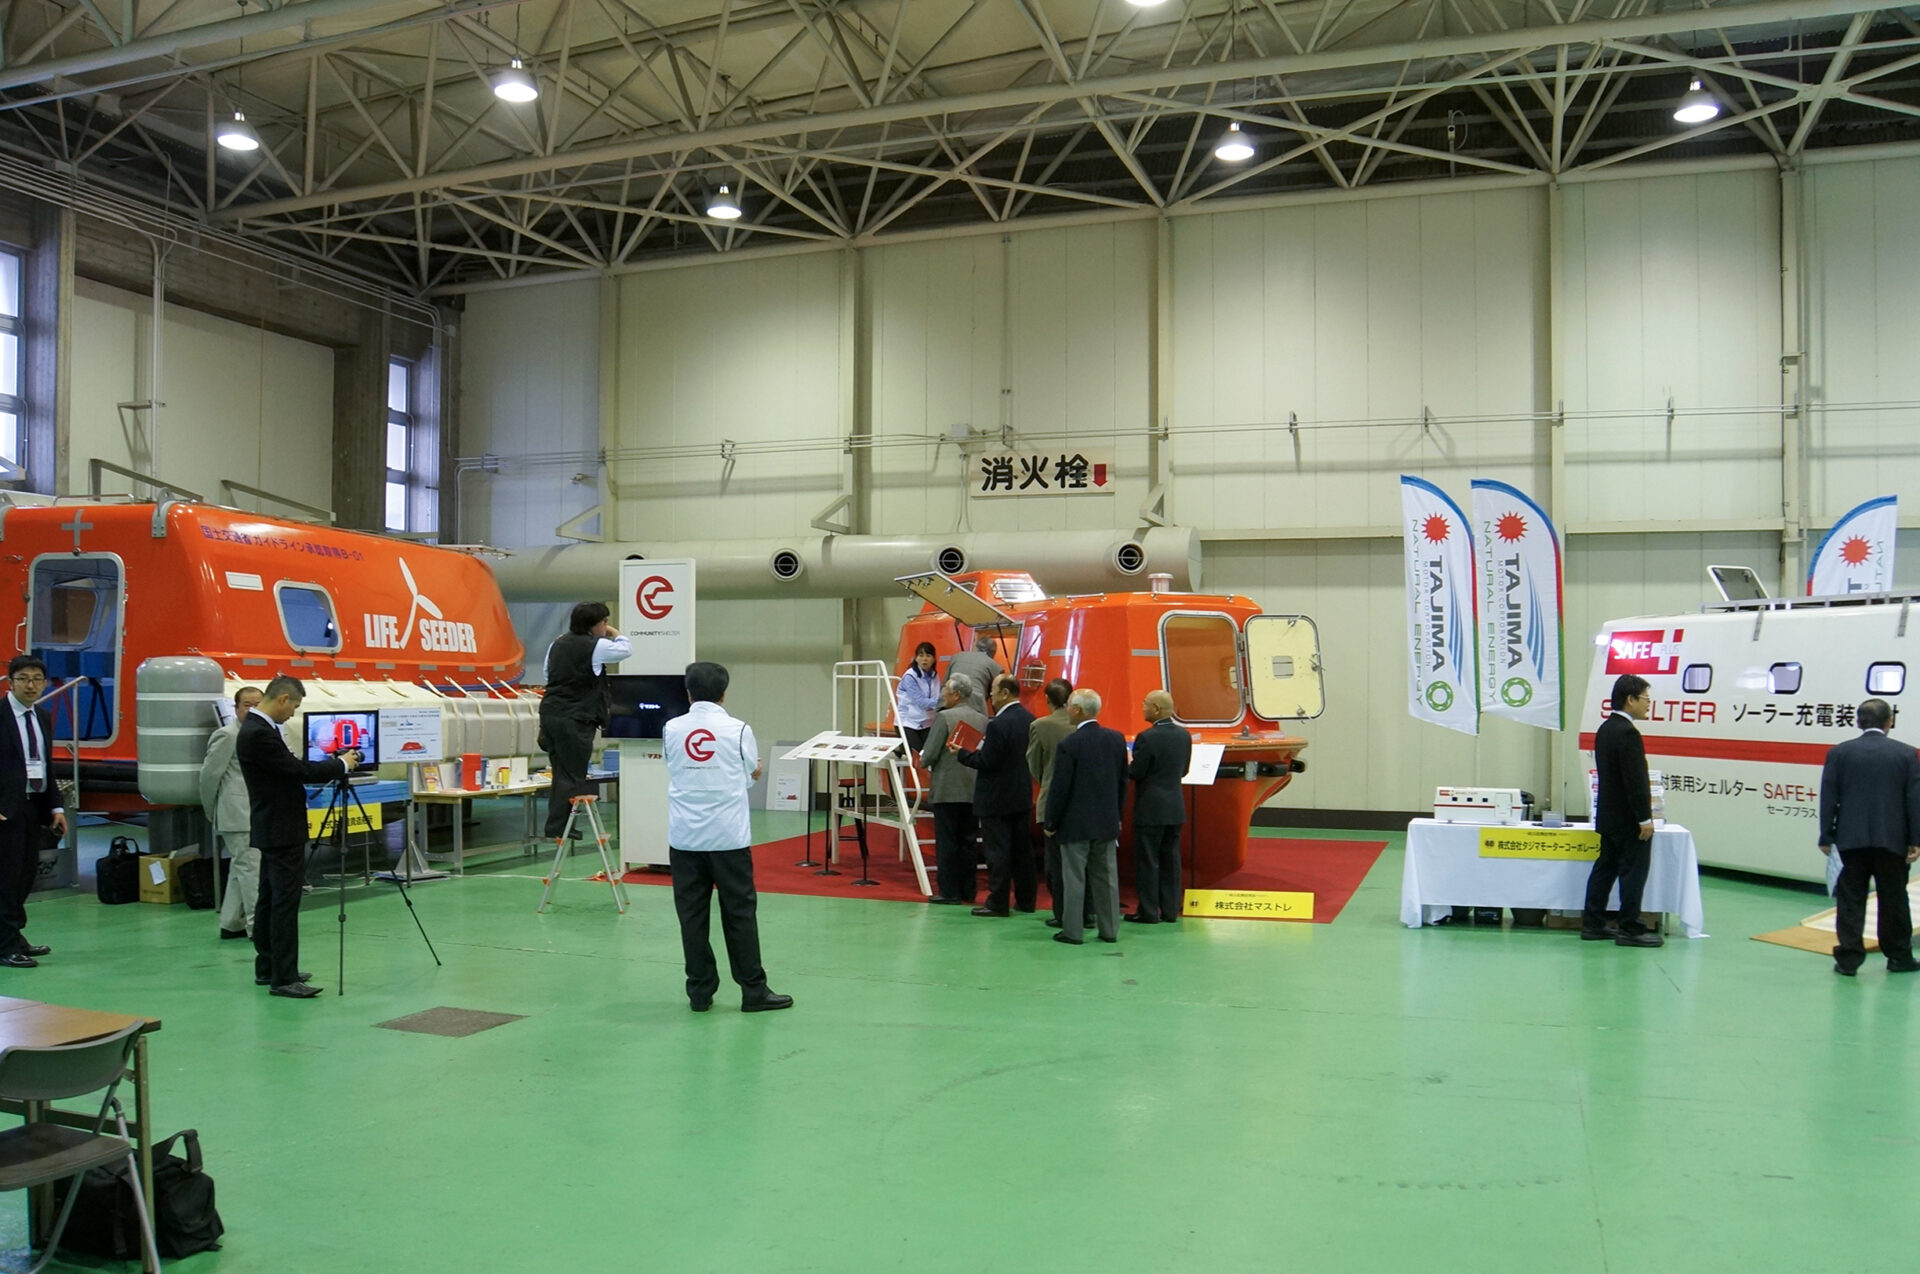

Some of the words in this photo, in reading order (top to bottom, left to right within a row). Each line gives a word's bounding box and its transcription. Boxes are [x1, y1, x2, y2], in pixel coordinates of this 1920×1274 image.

[981, 454, 1090, 491] 消火栓
[1411, 519, 1421, 614] NATURAL
[1483, 520, 1494, 613] NATURAL
[1429, 555, 1445, 672] TAJIMA
[1504, 552, 1523, 669] TAJIMA
[364, 614, 401, 649] LIFE
[419, 618, 478, 654] SEEDER
[1613, 641, 1652, 659] SAFE
[1413, 623, 1423, 705] ENERGY
[1487, 622, 1497, 703] ENERGY
[1600, 699, 1716, 724] SLTER
[1733, 703, 1899, 729] ソーラー充電装
[1764, 783, 1817, 801] SAFE+
[1497, 840, 1601, 853] 株式会社タジマモーターコーポレーシ
[1215, 900, 1293, 912] 株式会社マストレ
